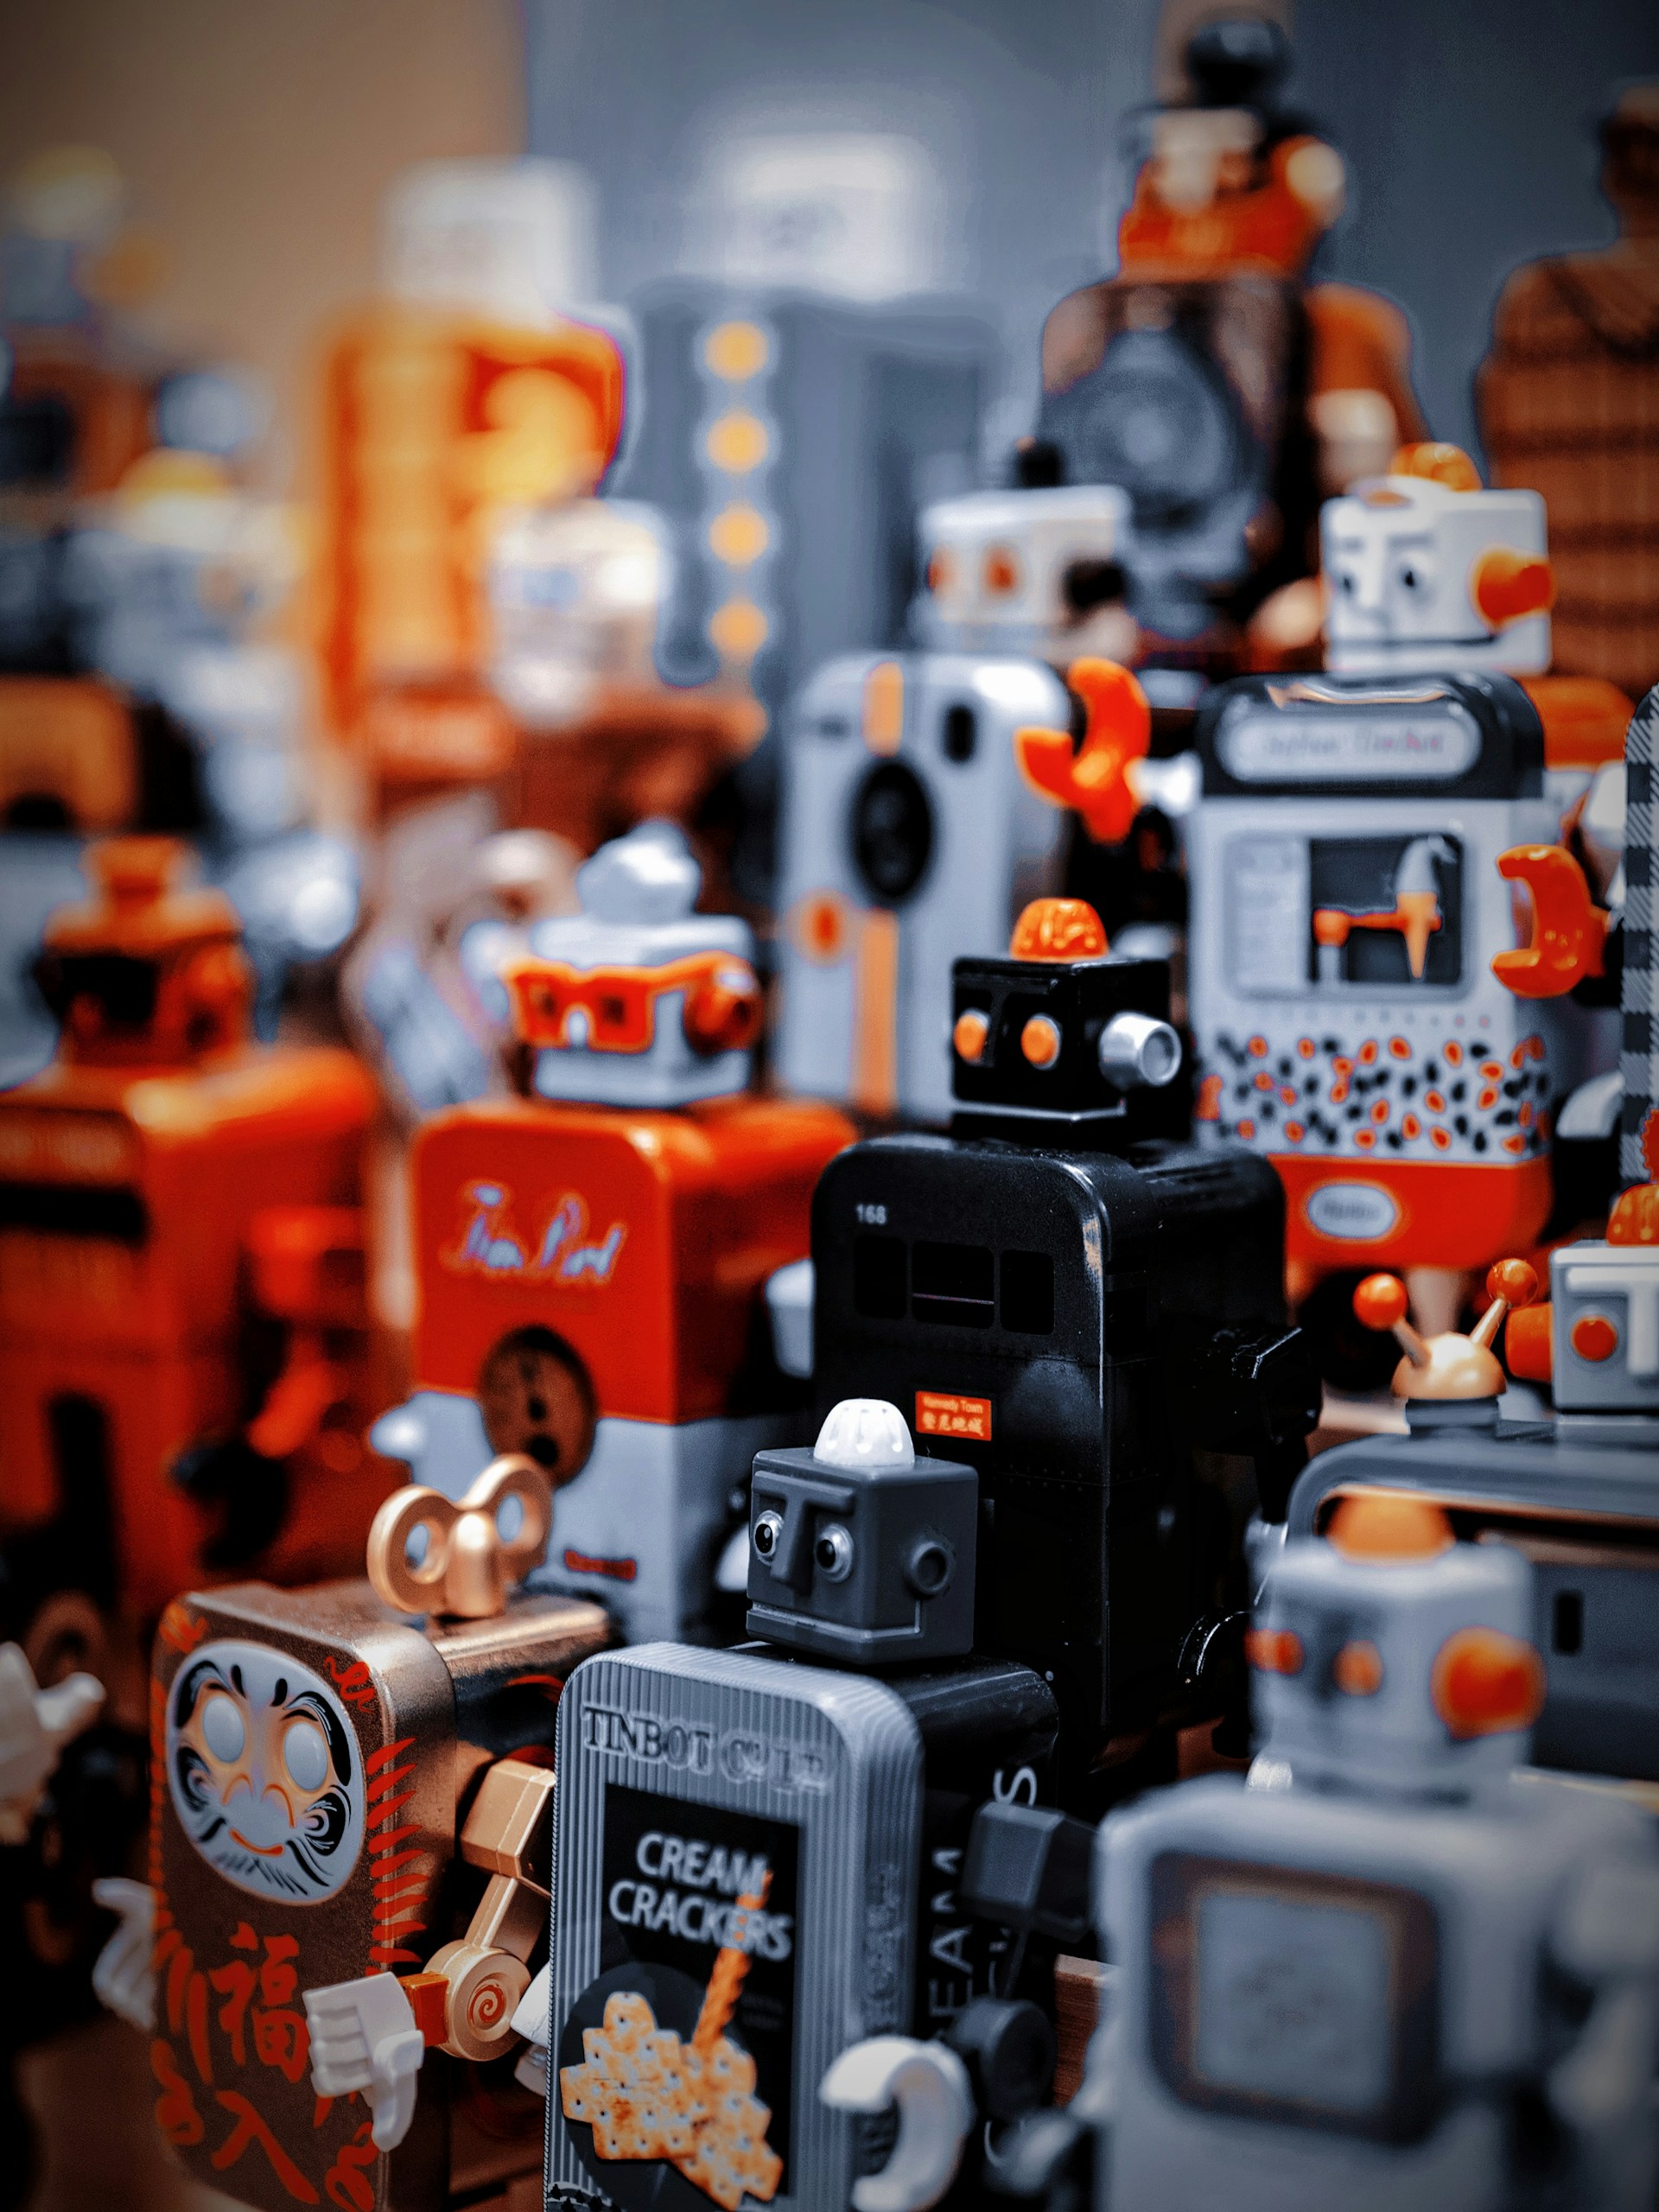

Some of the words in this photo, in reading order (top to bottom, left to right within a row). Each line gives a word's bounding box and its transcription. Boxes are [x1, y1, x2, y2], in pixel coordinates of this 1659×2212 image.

[582, 1703, 715, 1777] TINBOT
[636, 1831, 768, 1897] CREAM
[608, 1879, 793, 1961] CRACKERS
